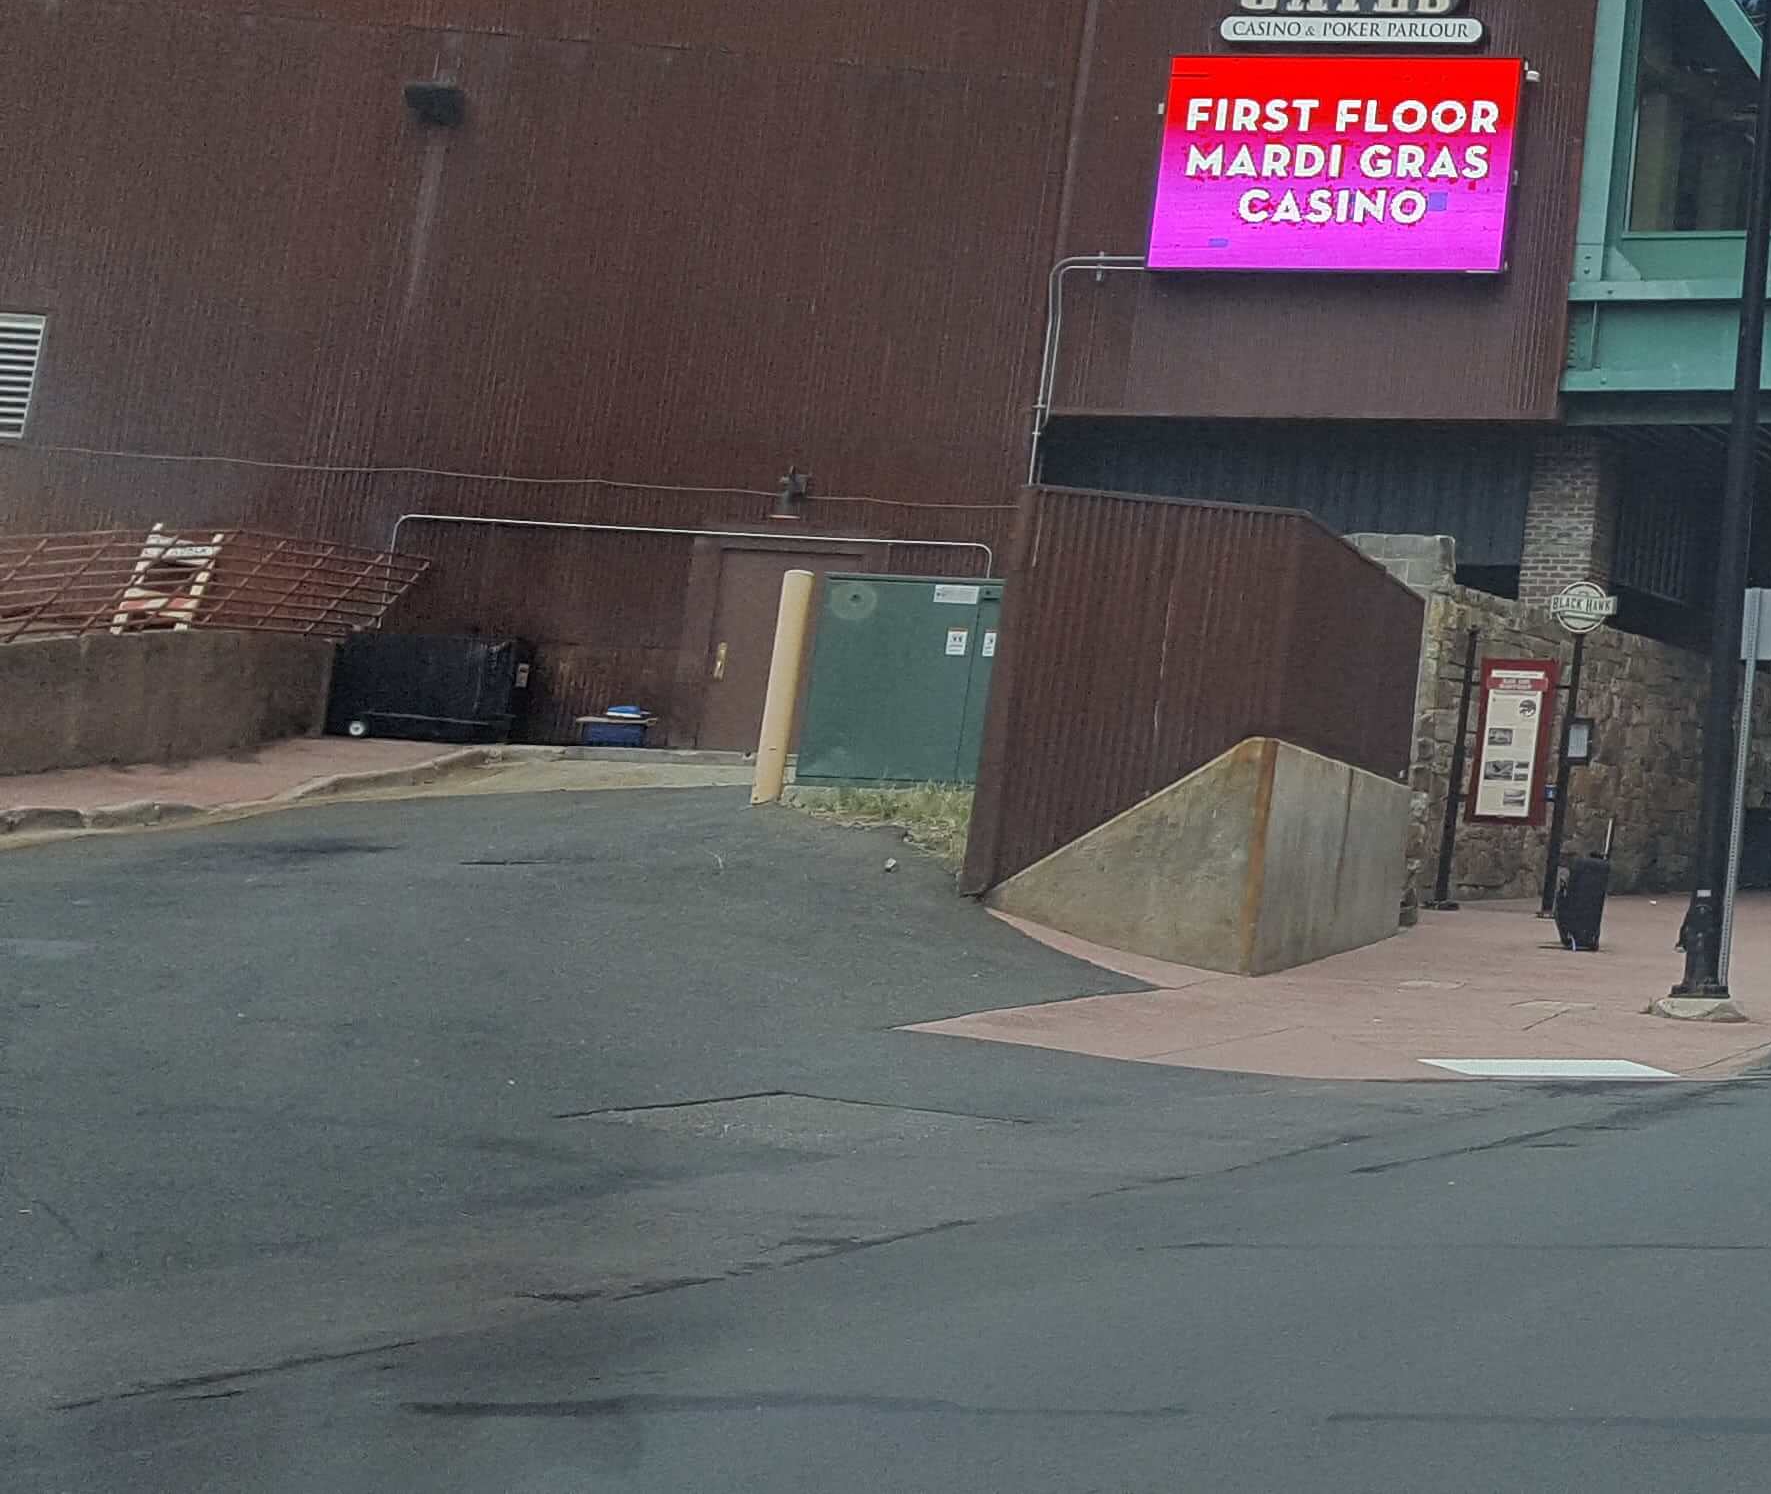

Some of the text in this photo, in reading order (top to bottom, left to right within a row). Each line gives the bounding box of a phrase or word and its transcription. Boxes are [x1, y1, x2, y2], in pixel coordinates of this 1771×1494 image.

[1232, 21, 1470, 38] CASINO & POKER PARLOUR
[1185, 98, 1500, 134] FIRST FLOOR
[1184, 144, 1490, 179] MARDI GRAS
[1238, 189, 1427, 224] CASINO
[1552, 596, 1611, 613] BLACK HAWK
